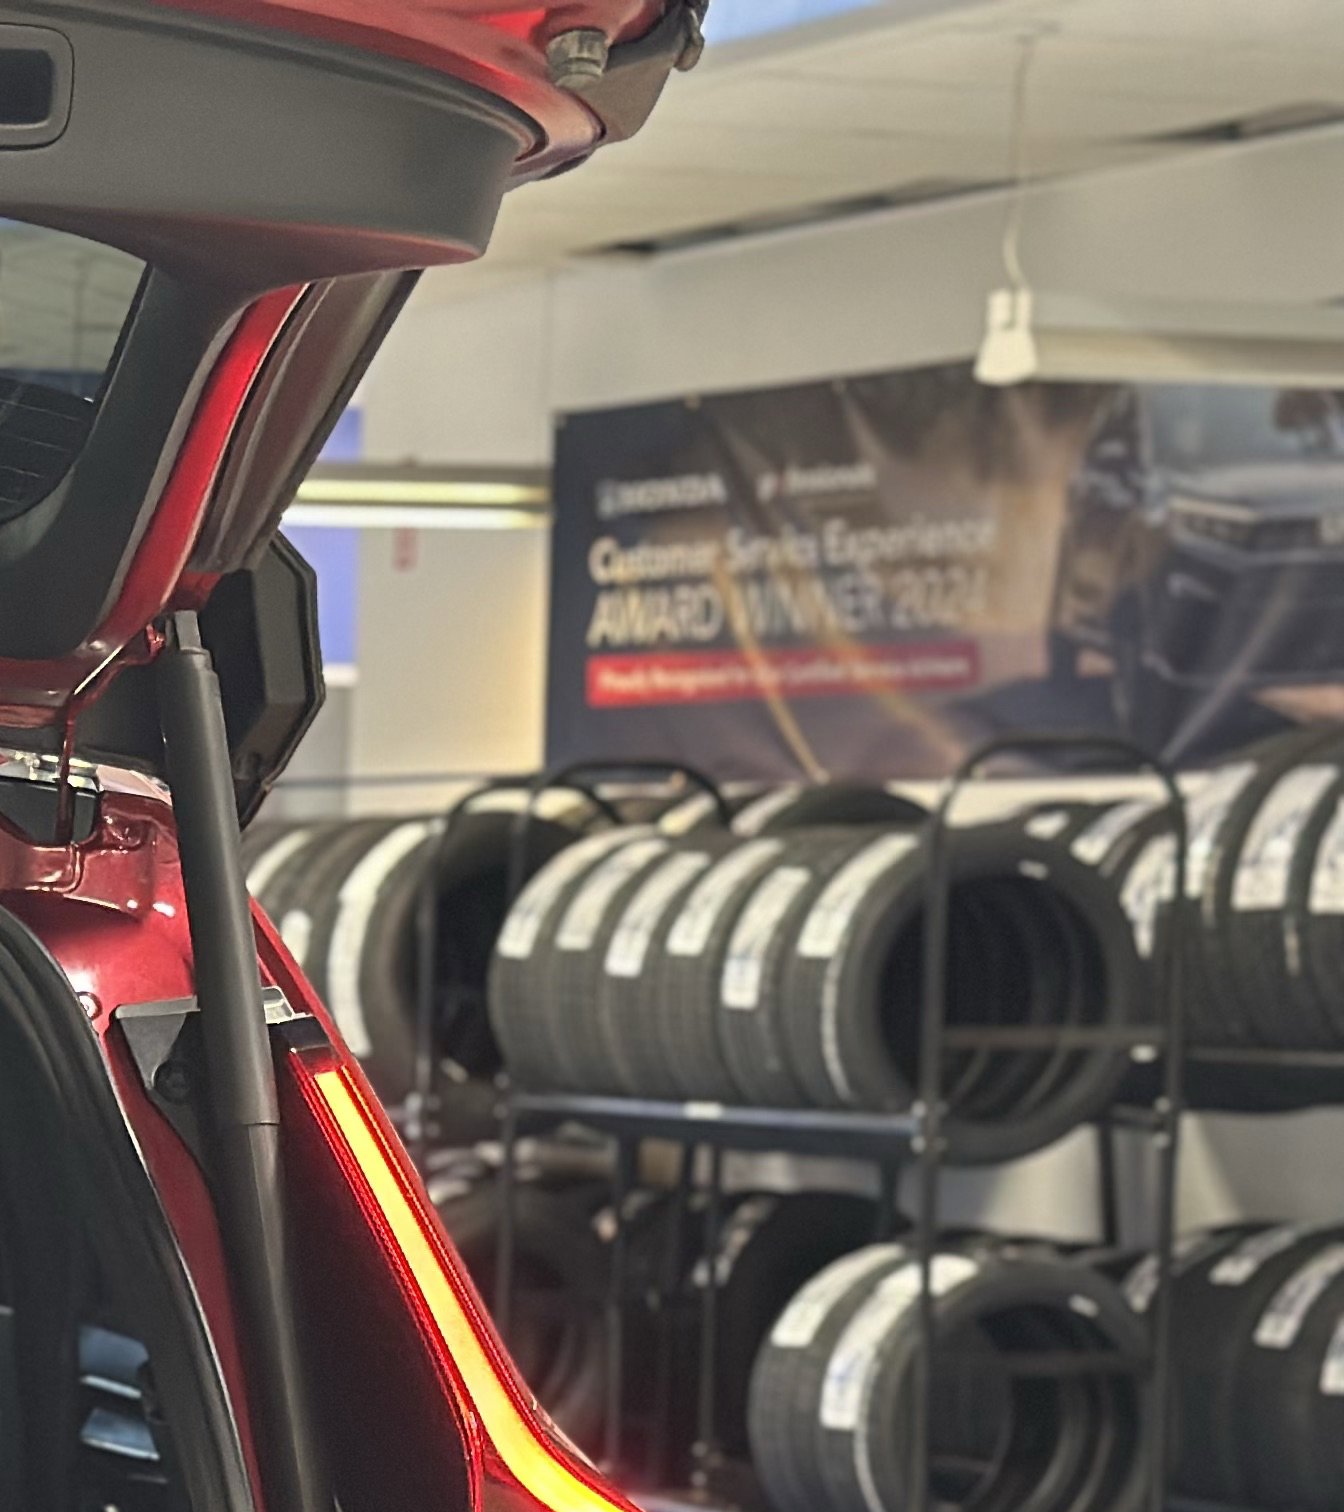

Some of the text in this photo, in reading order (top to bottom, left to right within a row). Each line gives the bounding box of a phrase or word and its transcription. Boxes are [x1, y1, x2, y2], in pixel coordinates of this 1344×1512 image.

[587, 536, 718, 584] Customer
[823, 513, 999, 573] Experience
[585, 582, 724, 648] AWARD
